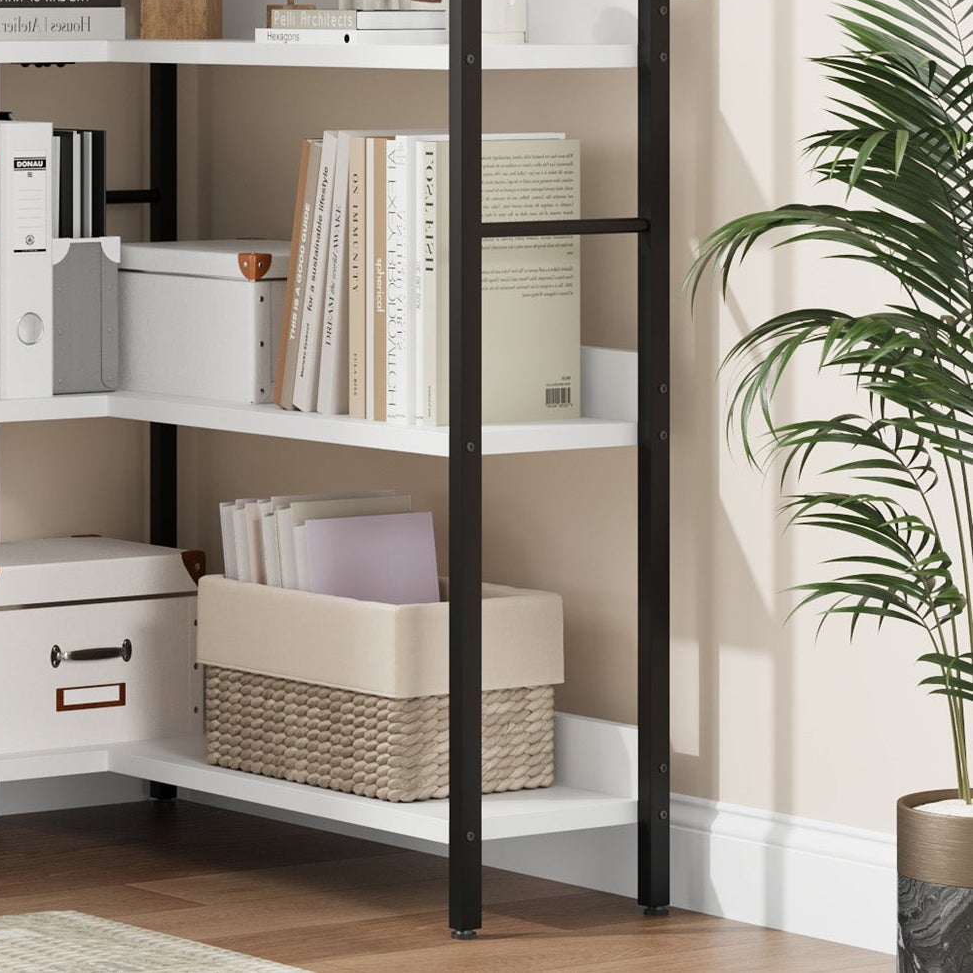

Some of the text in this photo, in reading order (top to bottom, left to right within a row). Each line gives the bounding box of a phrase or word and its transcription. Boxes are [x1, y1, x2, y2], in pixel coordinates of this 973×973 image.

[267, 31, 299, 44] Hexagons
[274, 10, 353, 27] Pelli Architects
[318, 166, 329, 213] lifestyle
[352, 173, 359, 195] ON
[289, 203, 311, 340] THIS IS A GOOD GUIDE
[312, 215, 323, 283] sustainable
[310, 285, 315, 293] a
[375, 257, 385, 313] spherical
[325, 296, 334, 345] DREAM
